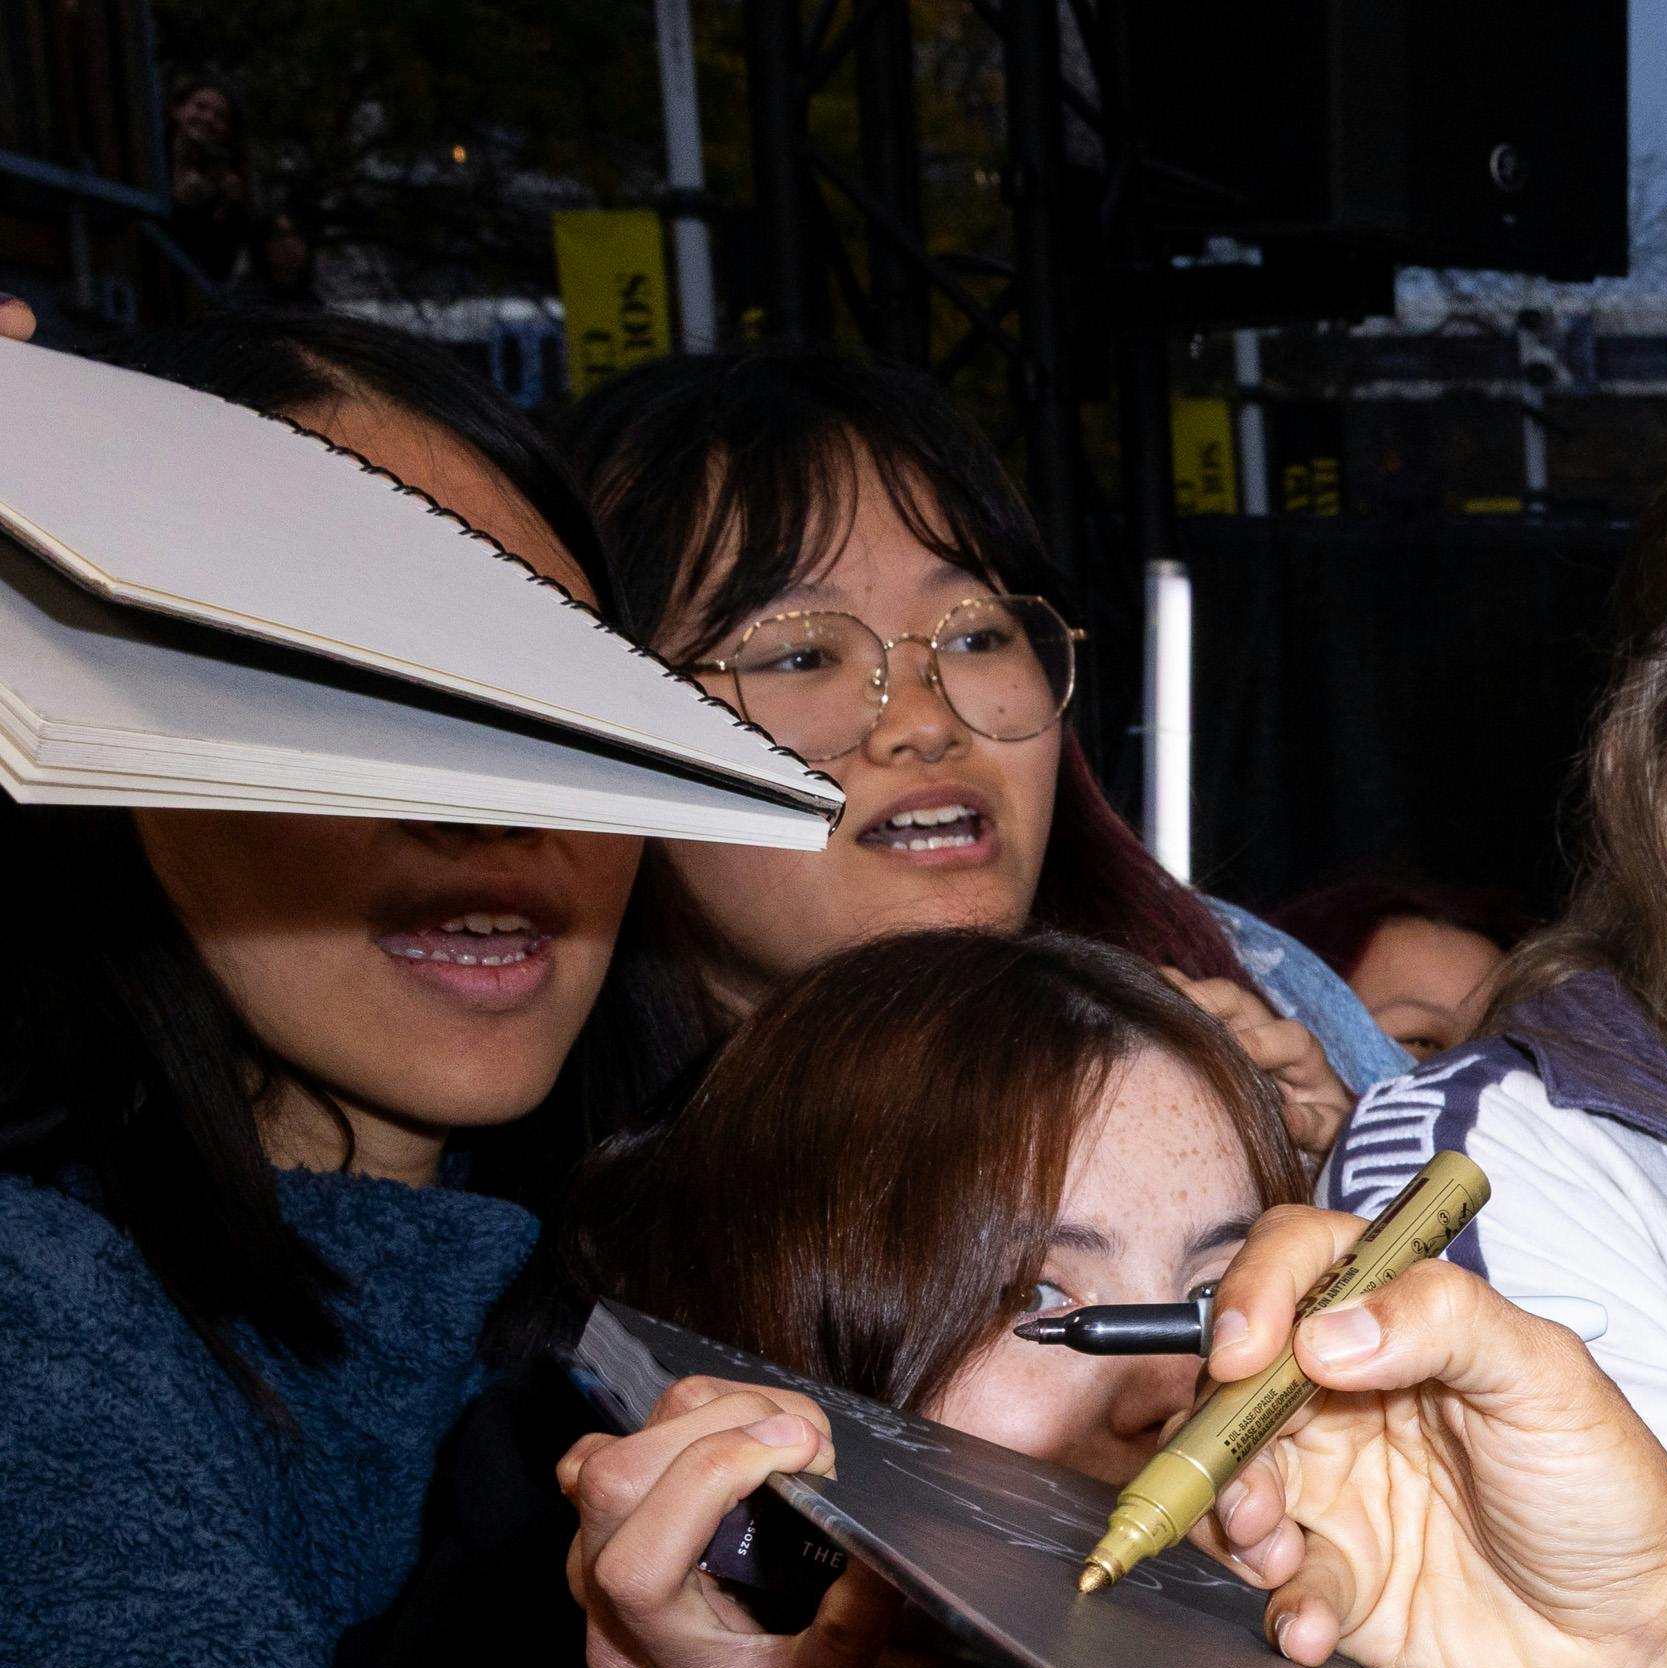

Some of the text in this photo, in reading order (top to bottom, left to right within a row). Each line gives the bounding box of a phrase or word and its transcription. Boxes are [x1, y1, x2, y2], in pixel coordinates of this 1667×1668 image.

[1319, 1266, 1359, 1308] ON ANYTHING
[1228, 1388, 1279, 1442] OIL-BASE/OPAQUE
[801, 1540, 844, 1568] THE
